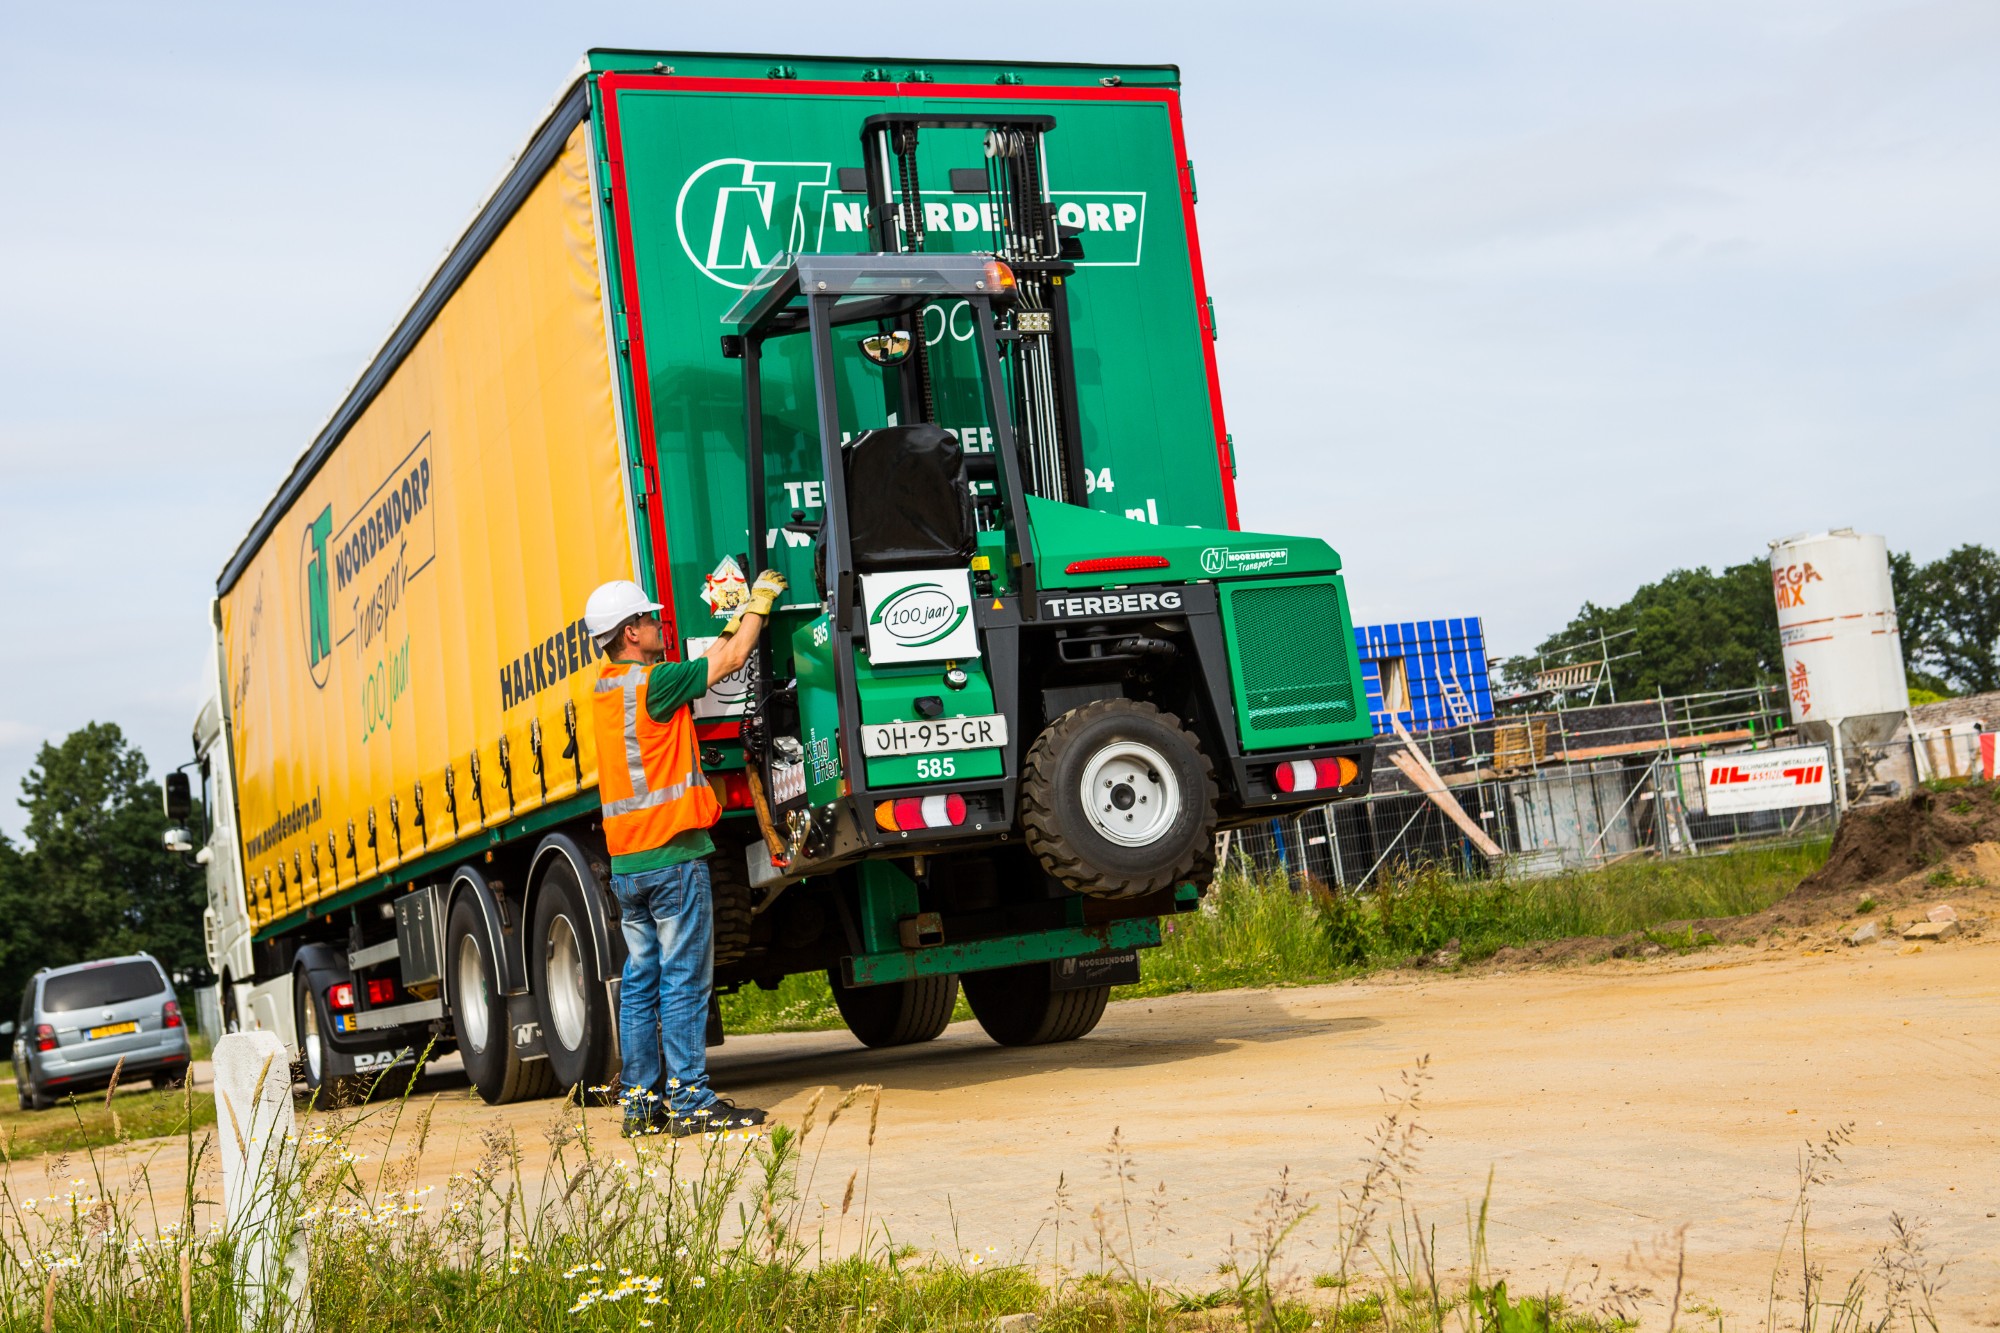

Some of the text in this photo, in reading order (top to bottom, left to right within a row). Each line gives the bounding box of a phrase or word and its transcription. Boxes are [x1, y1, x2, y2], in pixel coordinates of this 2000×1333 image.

[832, 202, 1137, 232] NRDEORP
[335, 457, 430, 591] NOORDENDORP
[1229, 551, 1286, 561] NOORDENDORP
[1238, 558, 1273, 572] Transport
[353, 531, 409, 660] Transport
[1045, 591, 1182, 617] TERBERG
[891, 605, 950, 626] 100 jaar
[813, 622, 828, 647] 585
[362, 634, 410, 745] 100 jaar
[876, 720, 994, 750] OH-95-GR
[916, 757, 956, 779] 585
[1079, 954, 1135, 968] NOORDENDORP
